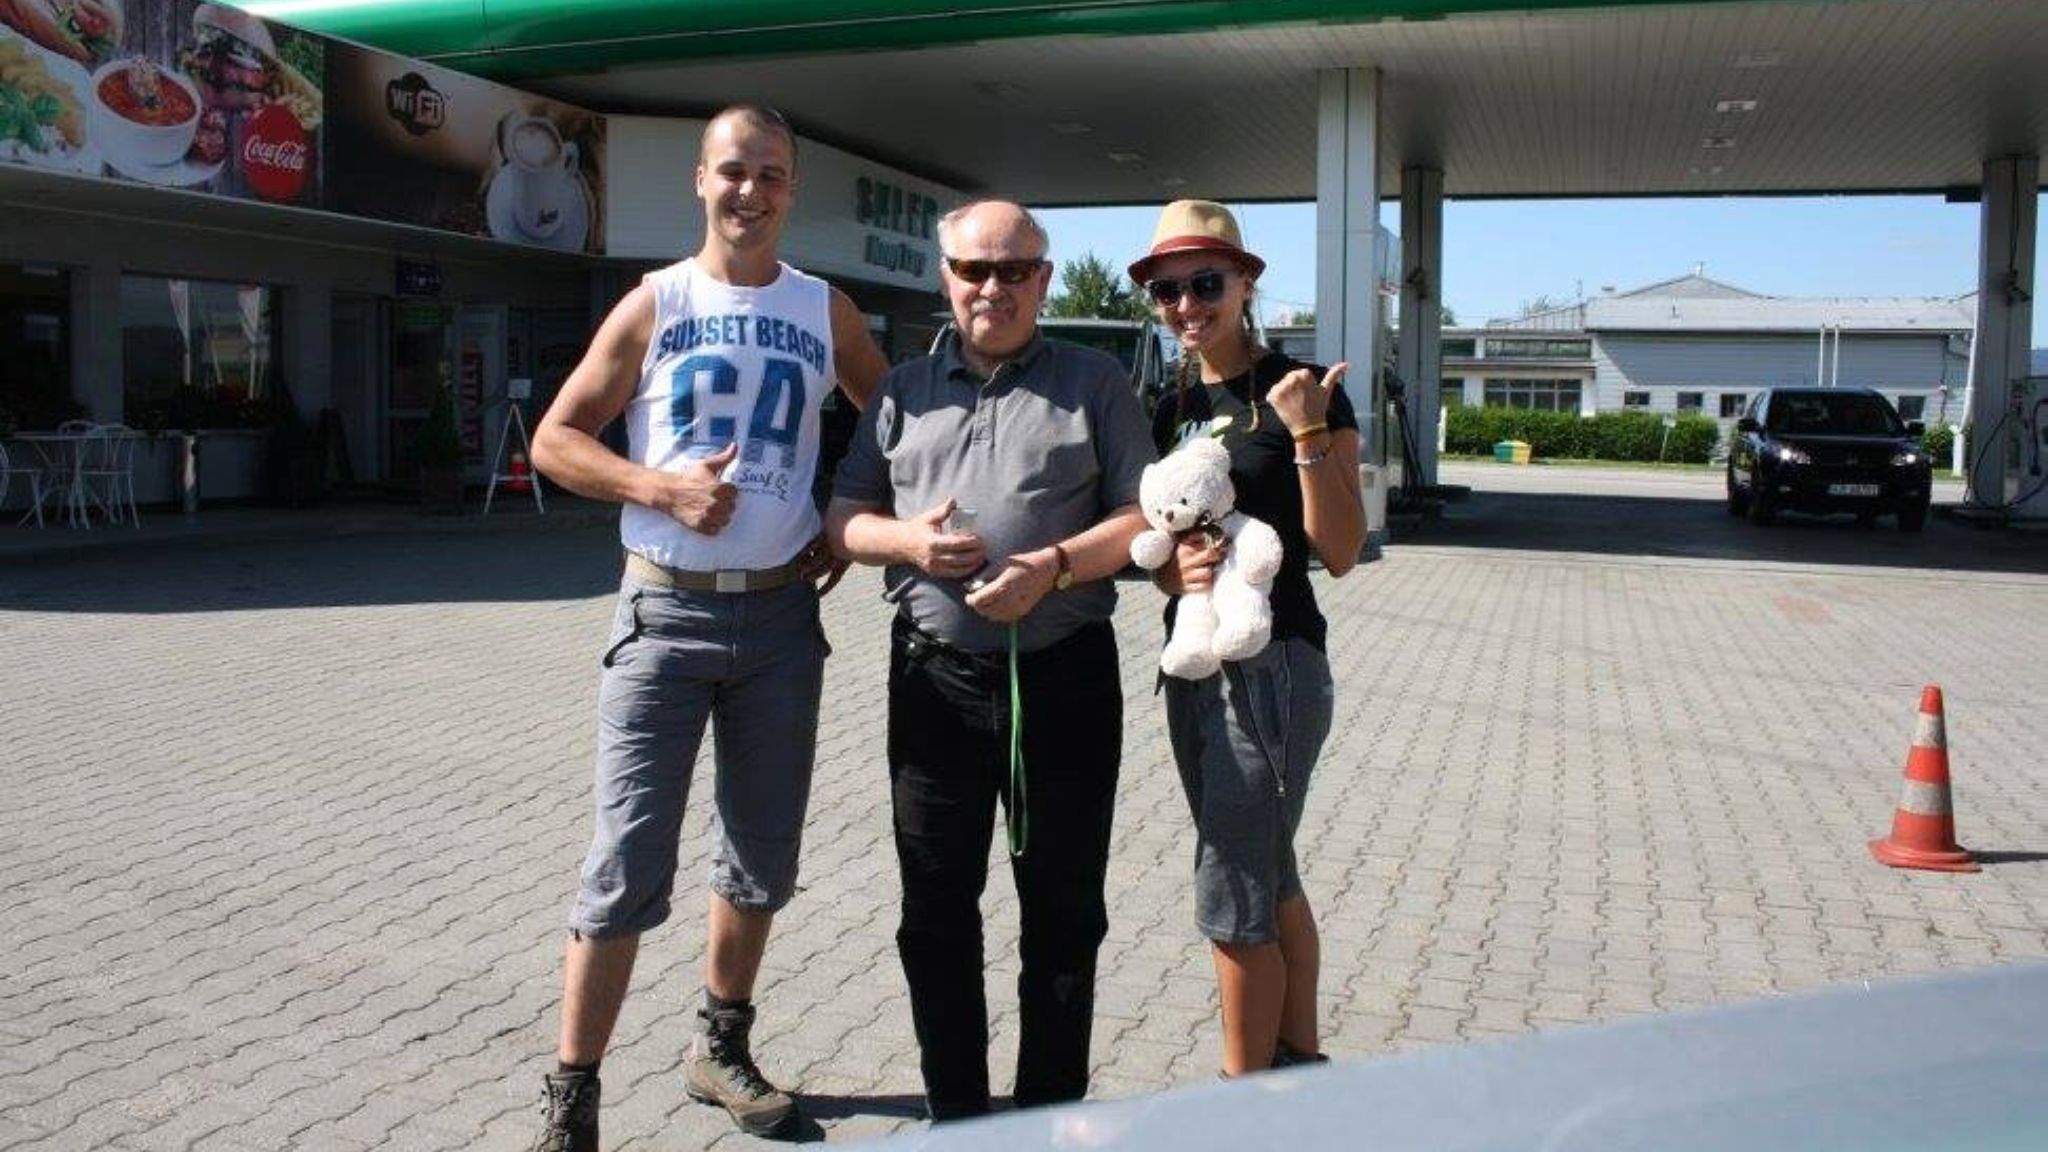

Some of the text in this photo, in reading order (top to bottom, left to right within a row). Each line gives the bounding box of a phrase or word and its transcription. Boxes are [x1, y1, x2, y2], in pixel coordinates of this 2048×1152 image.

[657, 315, 826, 376] SUNSET BEACH
[672, 355, 806, 468] CA
